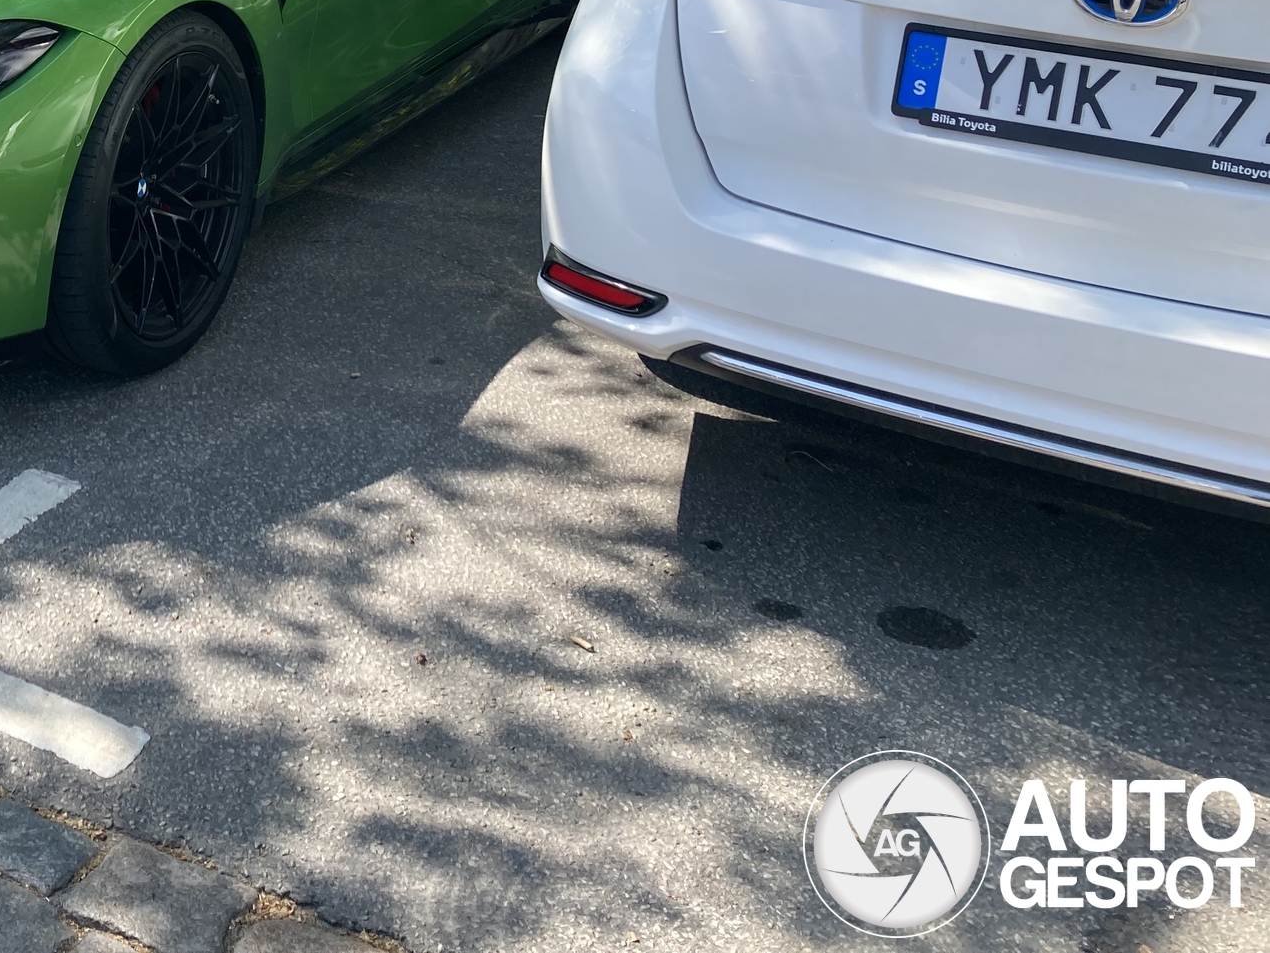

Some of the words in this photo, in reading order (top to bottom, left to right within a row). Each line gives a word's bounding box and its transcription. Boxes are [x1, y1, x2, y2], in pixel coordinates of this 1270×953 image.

[912, 79, 927, 96] S
[974, 49, 1121, 131] YMK
[1150, 75, 1270, 149] 77
[931, 112, 956, 126] Bilia
[958, 117, 997, 132] Toyota
